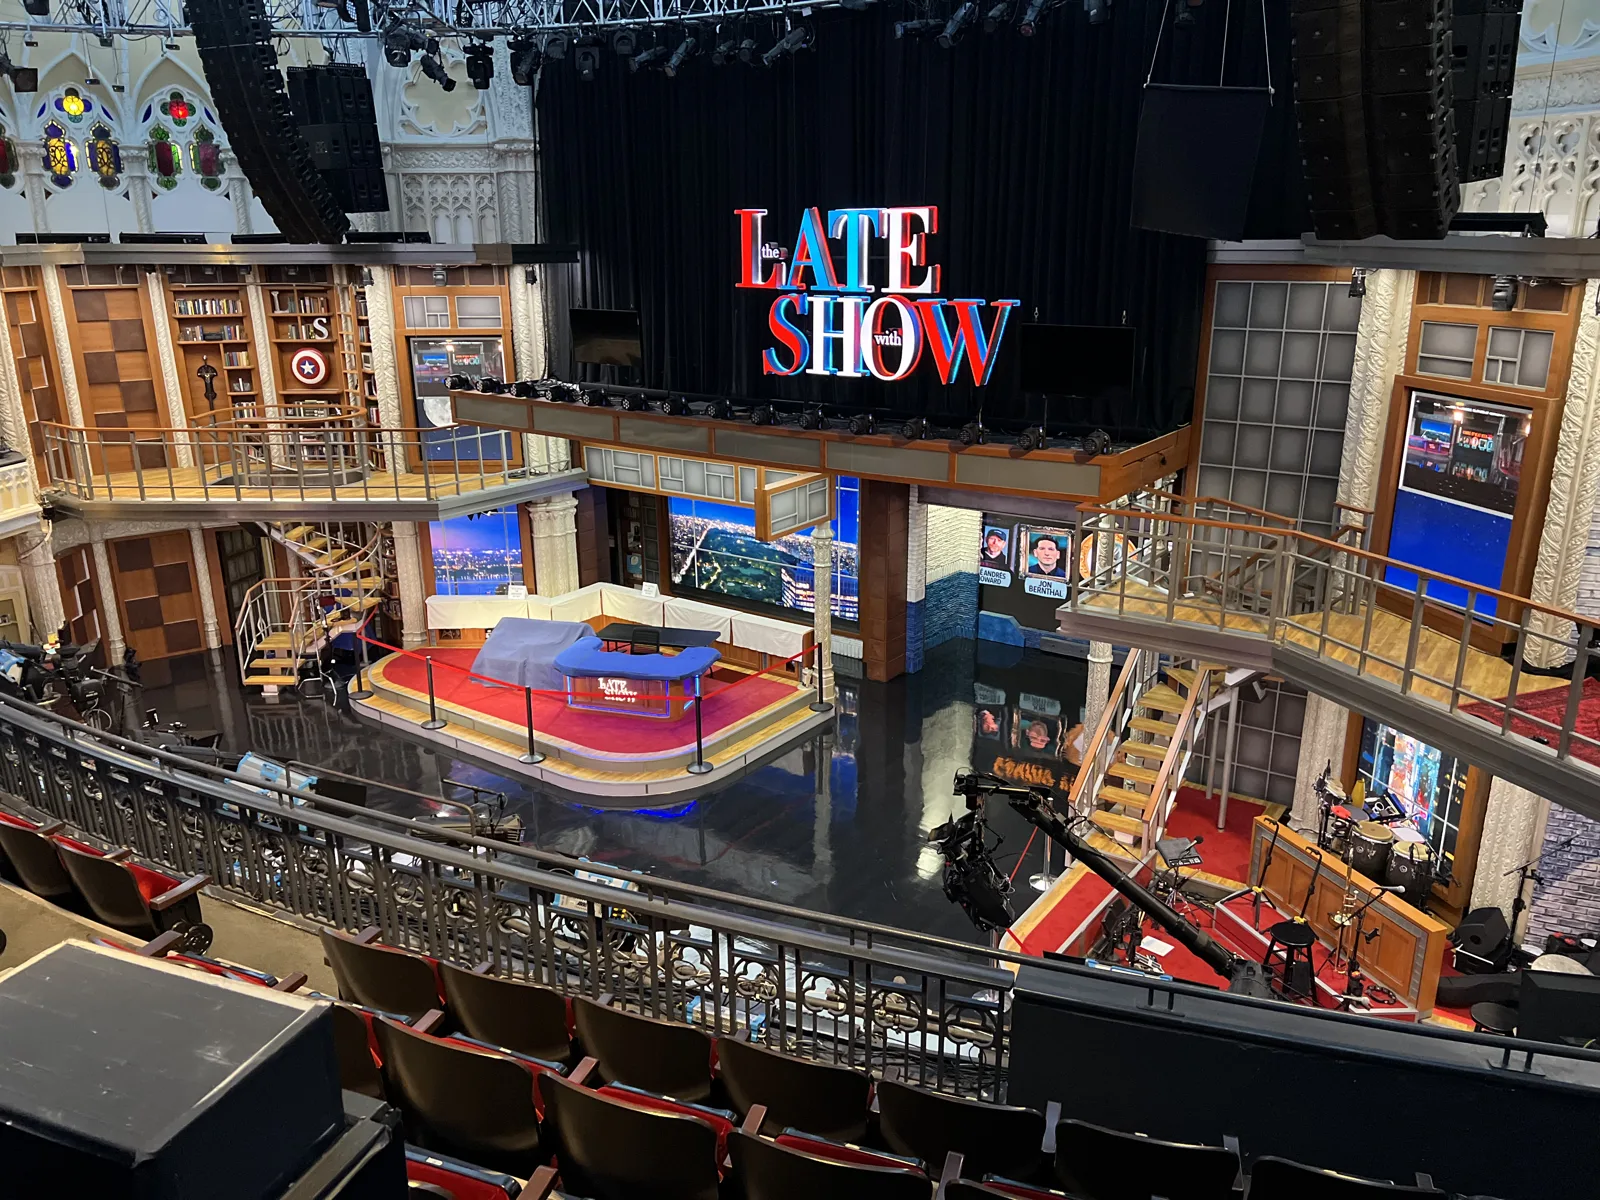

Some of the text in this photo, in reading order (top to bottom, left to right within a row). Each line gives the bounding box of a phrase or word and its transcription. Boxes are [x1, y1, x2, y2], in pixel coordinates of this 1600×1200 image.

[734, 206, 940, 293] LATE
[761, 243, 780, 259] the
[313, 317, 328, 340] S
[763, 293, 1020, 386] SHOW
[874, 330, 902, 346] with
[979, 576, 1001, 584] OWARD
[1028, 586, 1063, 597] BERNTHAL
